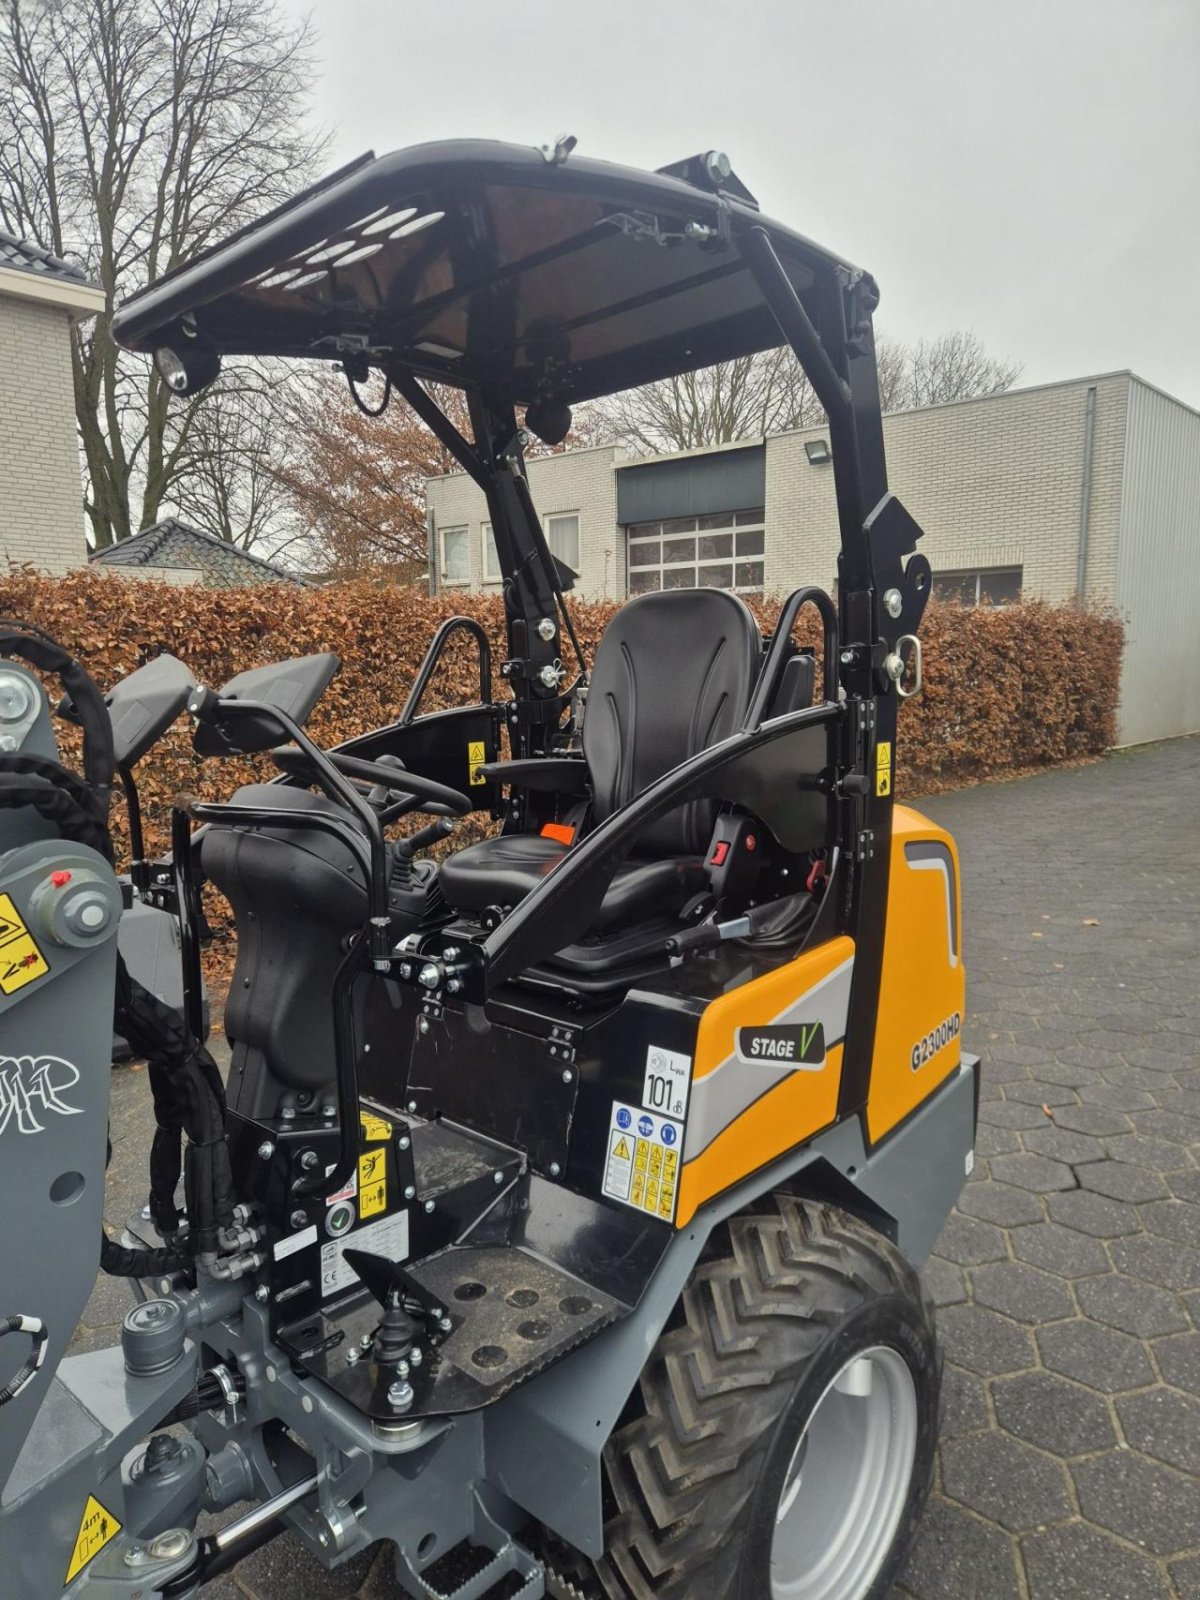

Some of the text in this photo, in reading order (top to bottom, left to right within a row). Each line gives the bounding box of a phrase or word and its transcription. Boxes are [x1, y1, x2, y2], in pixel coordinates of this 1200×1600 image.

[750, 1018, 820, 1059] STAGE V
[911, 1011, 960, 1071] G2300HD
[647, 1073, 683, 1115] 101 dB
[324, 1270, 337, 1284] CE
[83, 1512, 100, 1532] 4m
